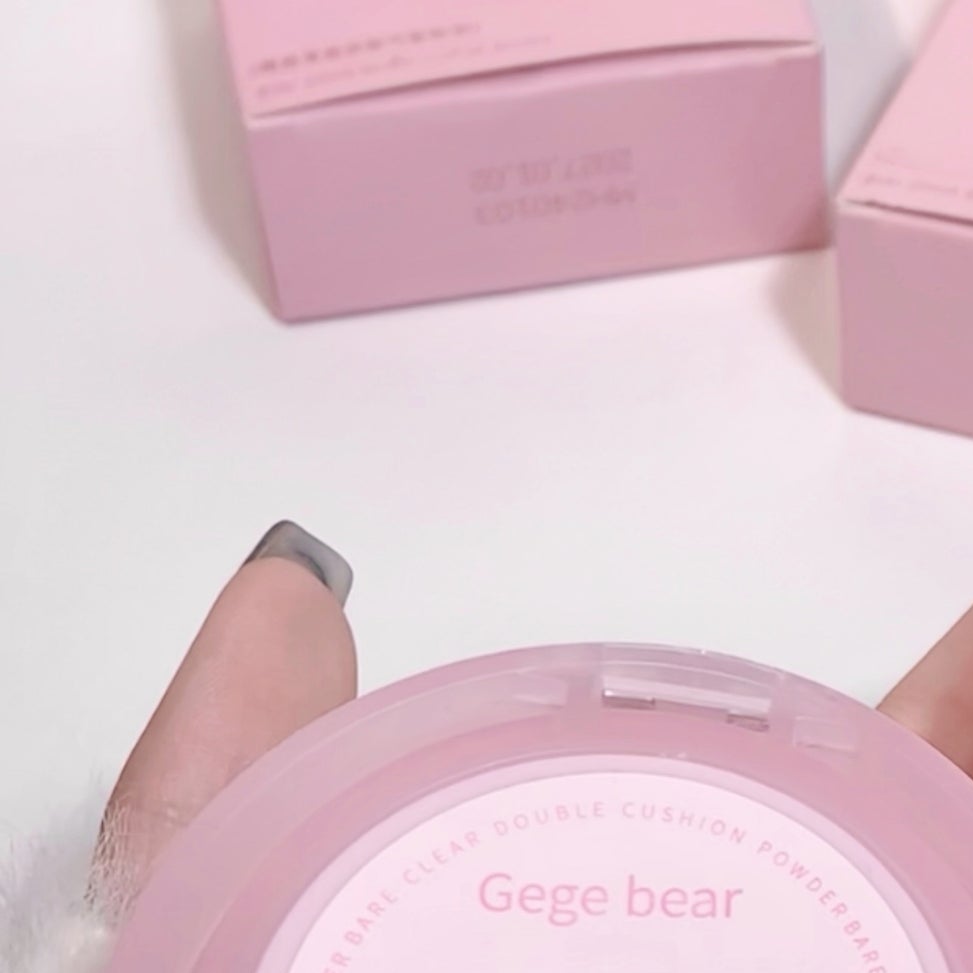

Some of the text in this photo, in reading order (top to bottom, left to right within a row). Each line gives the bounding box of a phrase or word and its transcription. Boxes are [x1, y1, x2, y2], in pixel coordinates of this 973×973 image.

[343, 801, 850, 948] BARE CLEAR DOUBLE CUSHION POWDER
[477, 870, 744, 927] Gege bear
